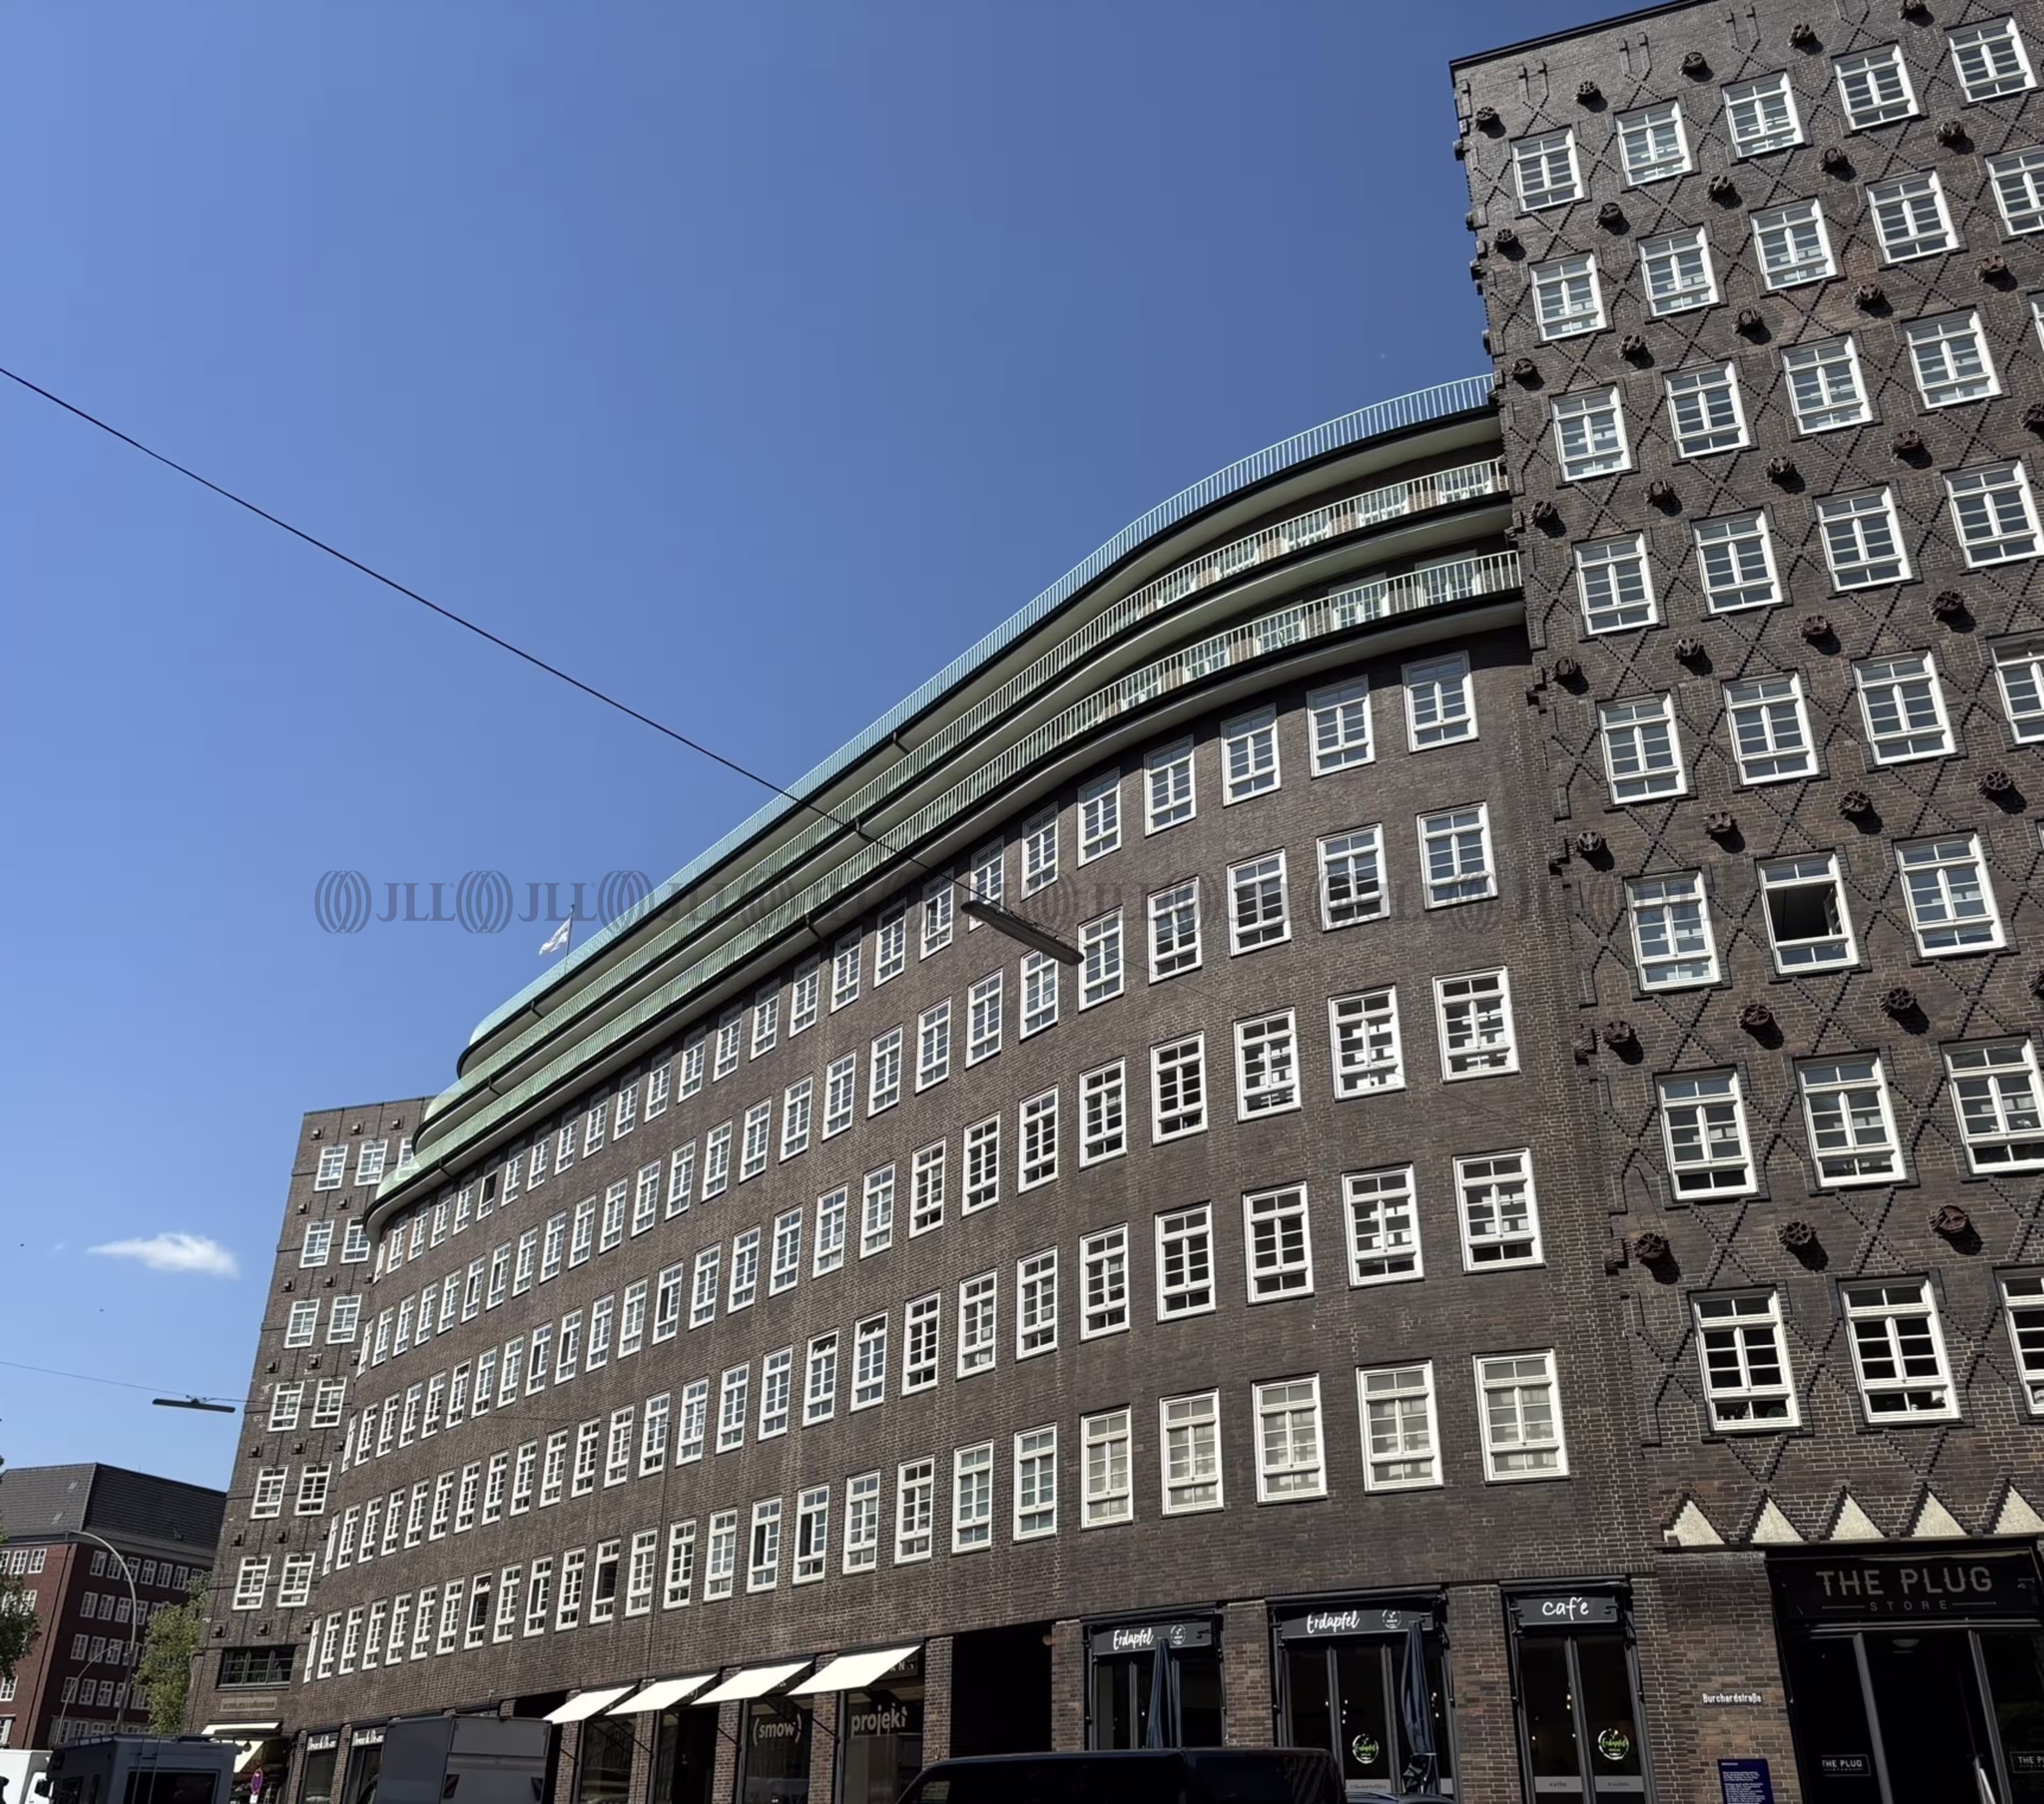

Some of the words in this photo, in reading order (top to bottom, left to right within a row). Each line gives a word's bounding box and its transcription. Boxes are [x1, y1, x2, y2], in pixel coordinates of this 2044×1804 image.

[1815, 1569, 1884, 1597] THE
[1900, 1567, 1993, 1595] PLUG
[1870, 1600, 1948, 1612] STORE
[1306, 1609, 1361, 1634] Erdapfel
[1113, 1627, 1154, 1651] Erdapfel
[1702, 1692, 1762, 1704] Burchardstraße
[851, 1703, 908, 1737] projekt
[1822, 1759, 1837, 1768] THE
[1840, 1759, 1862, 1767] PLUG
